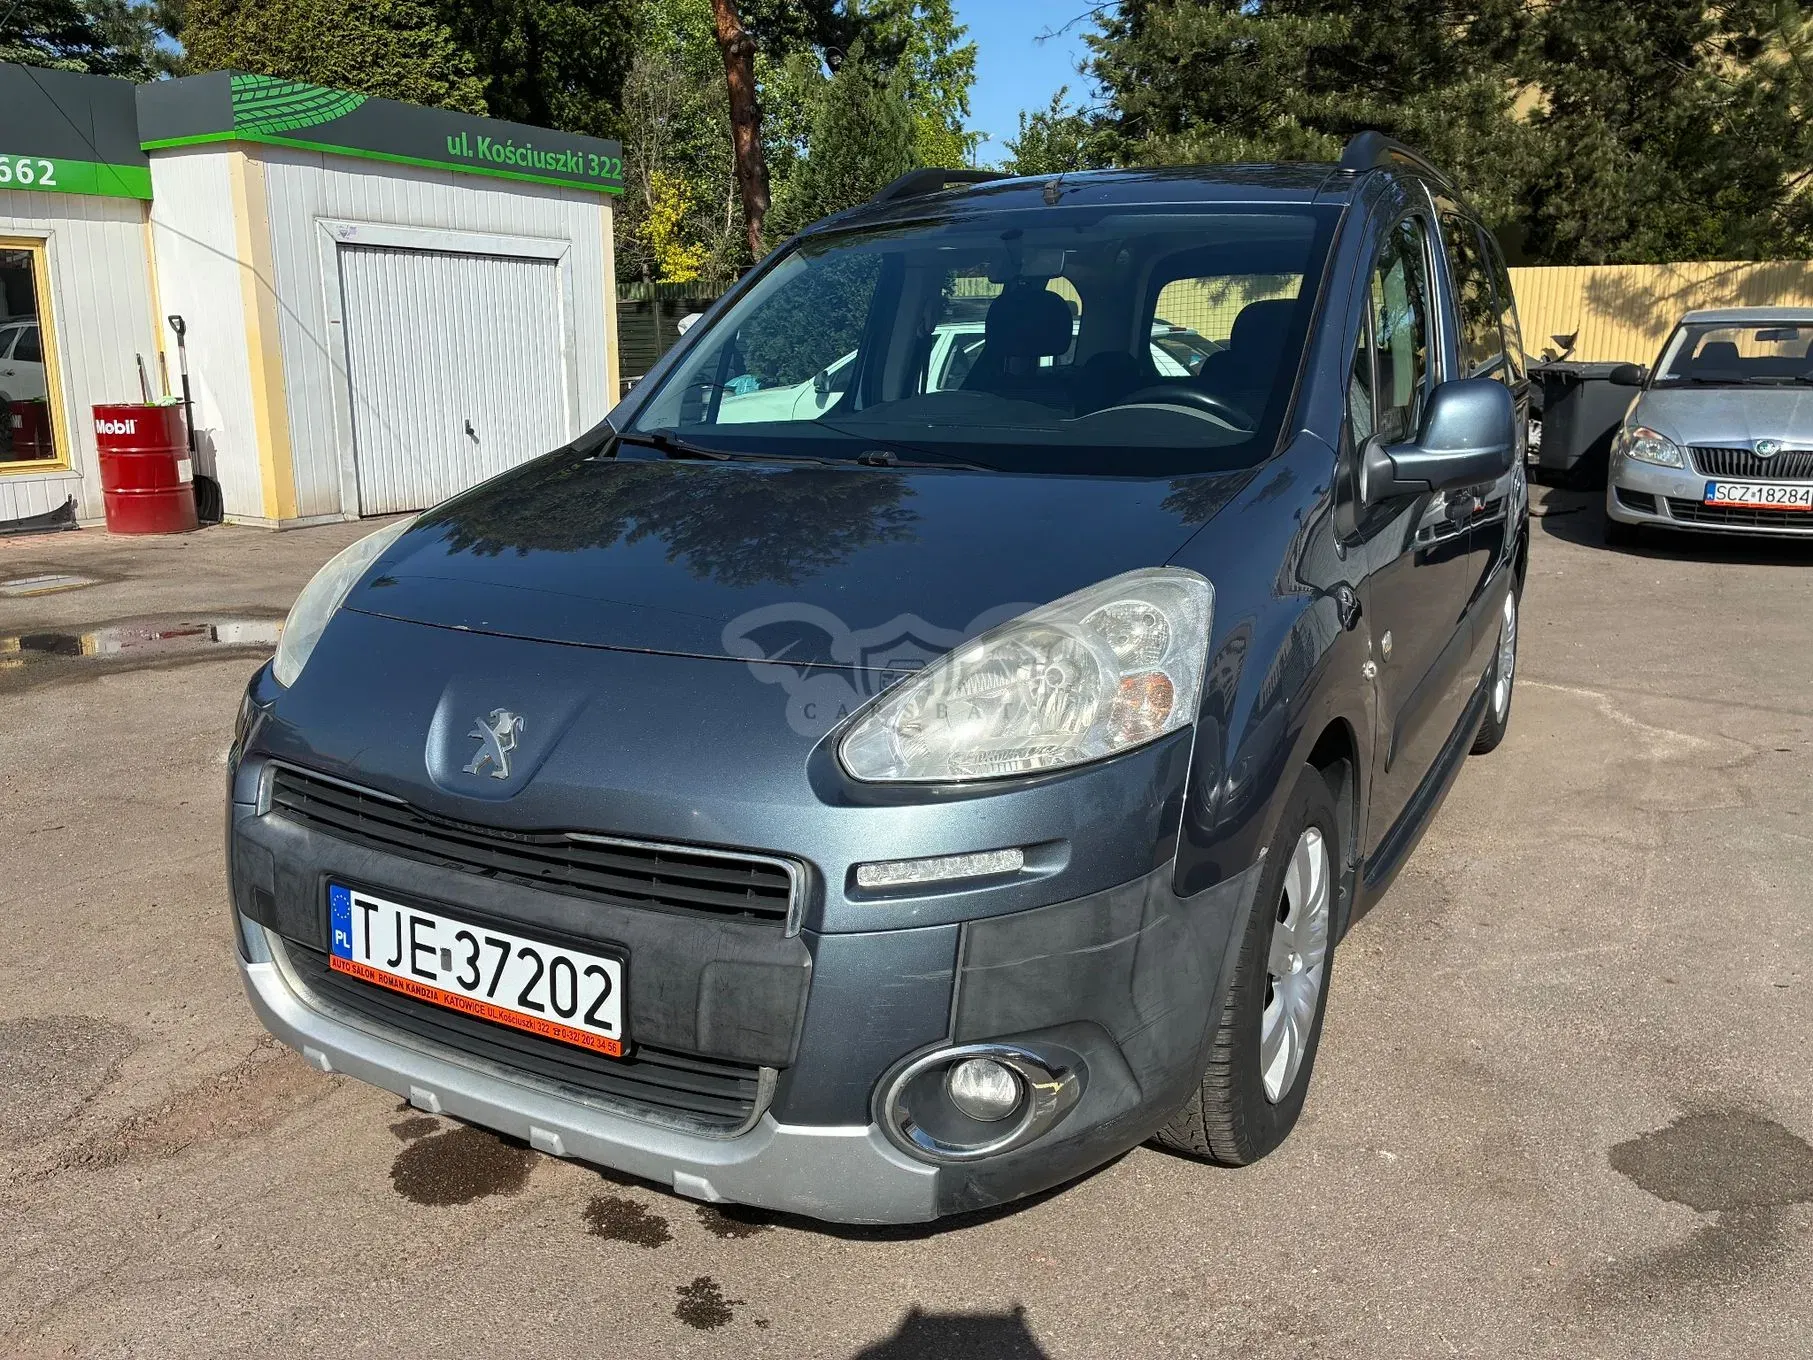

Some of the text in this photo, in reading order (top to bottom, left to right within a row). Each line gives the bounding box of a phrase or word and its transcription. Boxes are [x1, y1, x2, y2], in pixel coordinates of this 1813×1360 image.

[447, 131, 622, 180] ul. Kościuszki 322
[96, 419, 136, 435] Mobil
[335, 929, 350, 949] PL
[332, 957, 351, 972] AUTO
[352, 964, 375, 980] SALON
[378, 973, 404, 991] ROMAN
[405, 982, 439, 1001] KANDZIA
[443, 993, 487, 1015] KATOWICE
[537, 1021, 550, 1034] 322
[581, 1033, 595, 1047] 202
[596, 1038, 606, 1050] 34
[607, 1041, 617, 1053] 56
